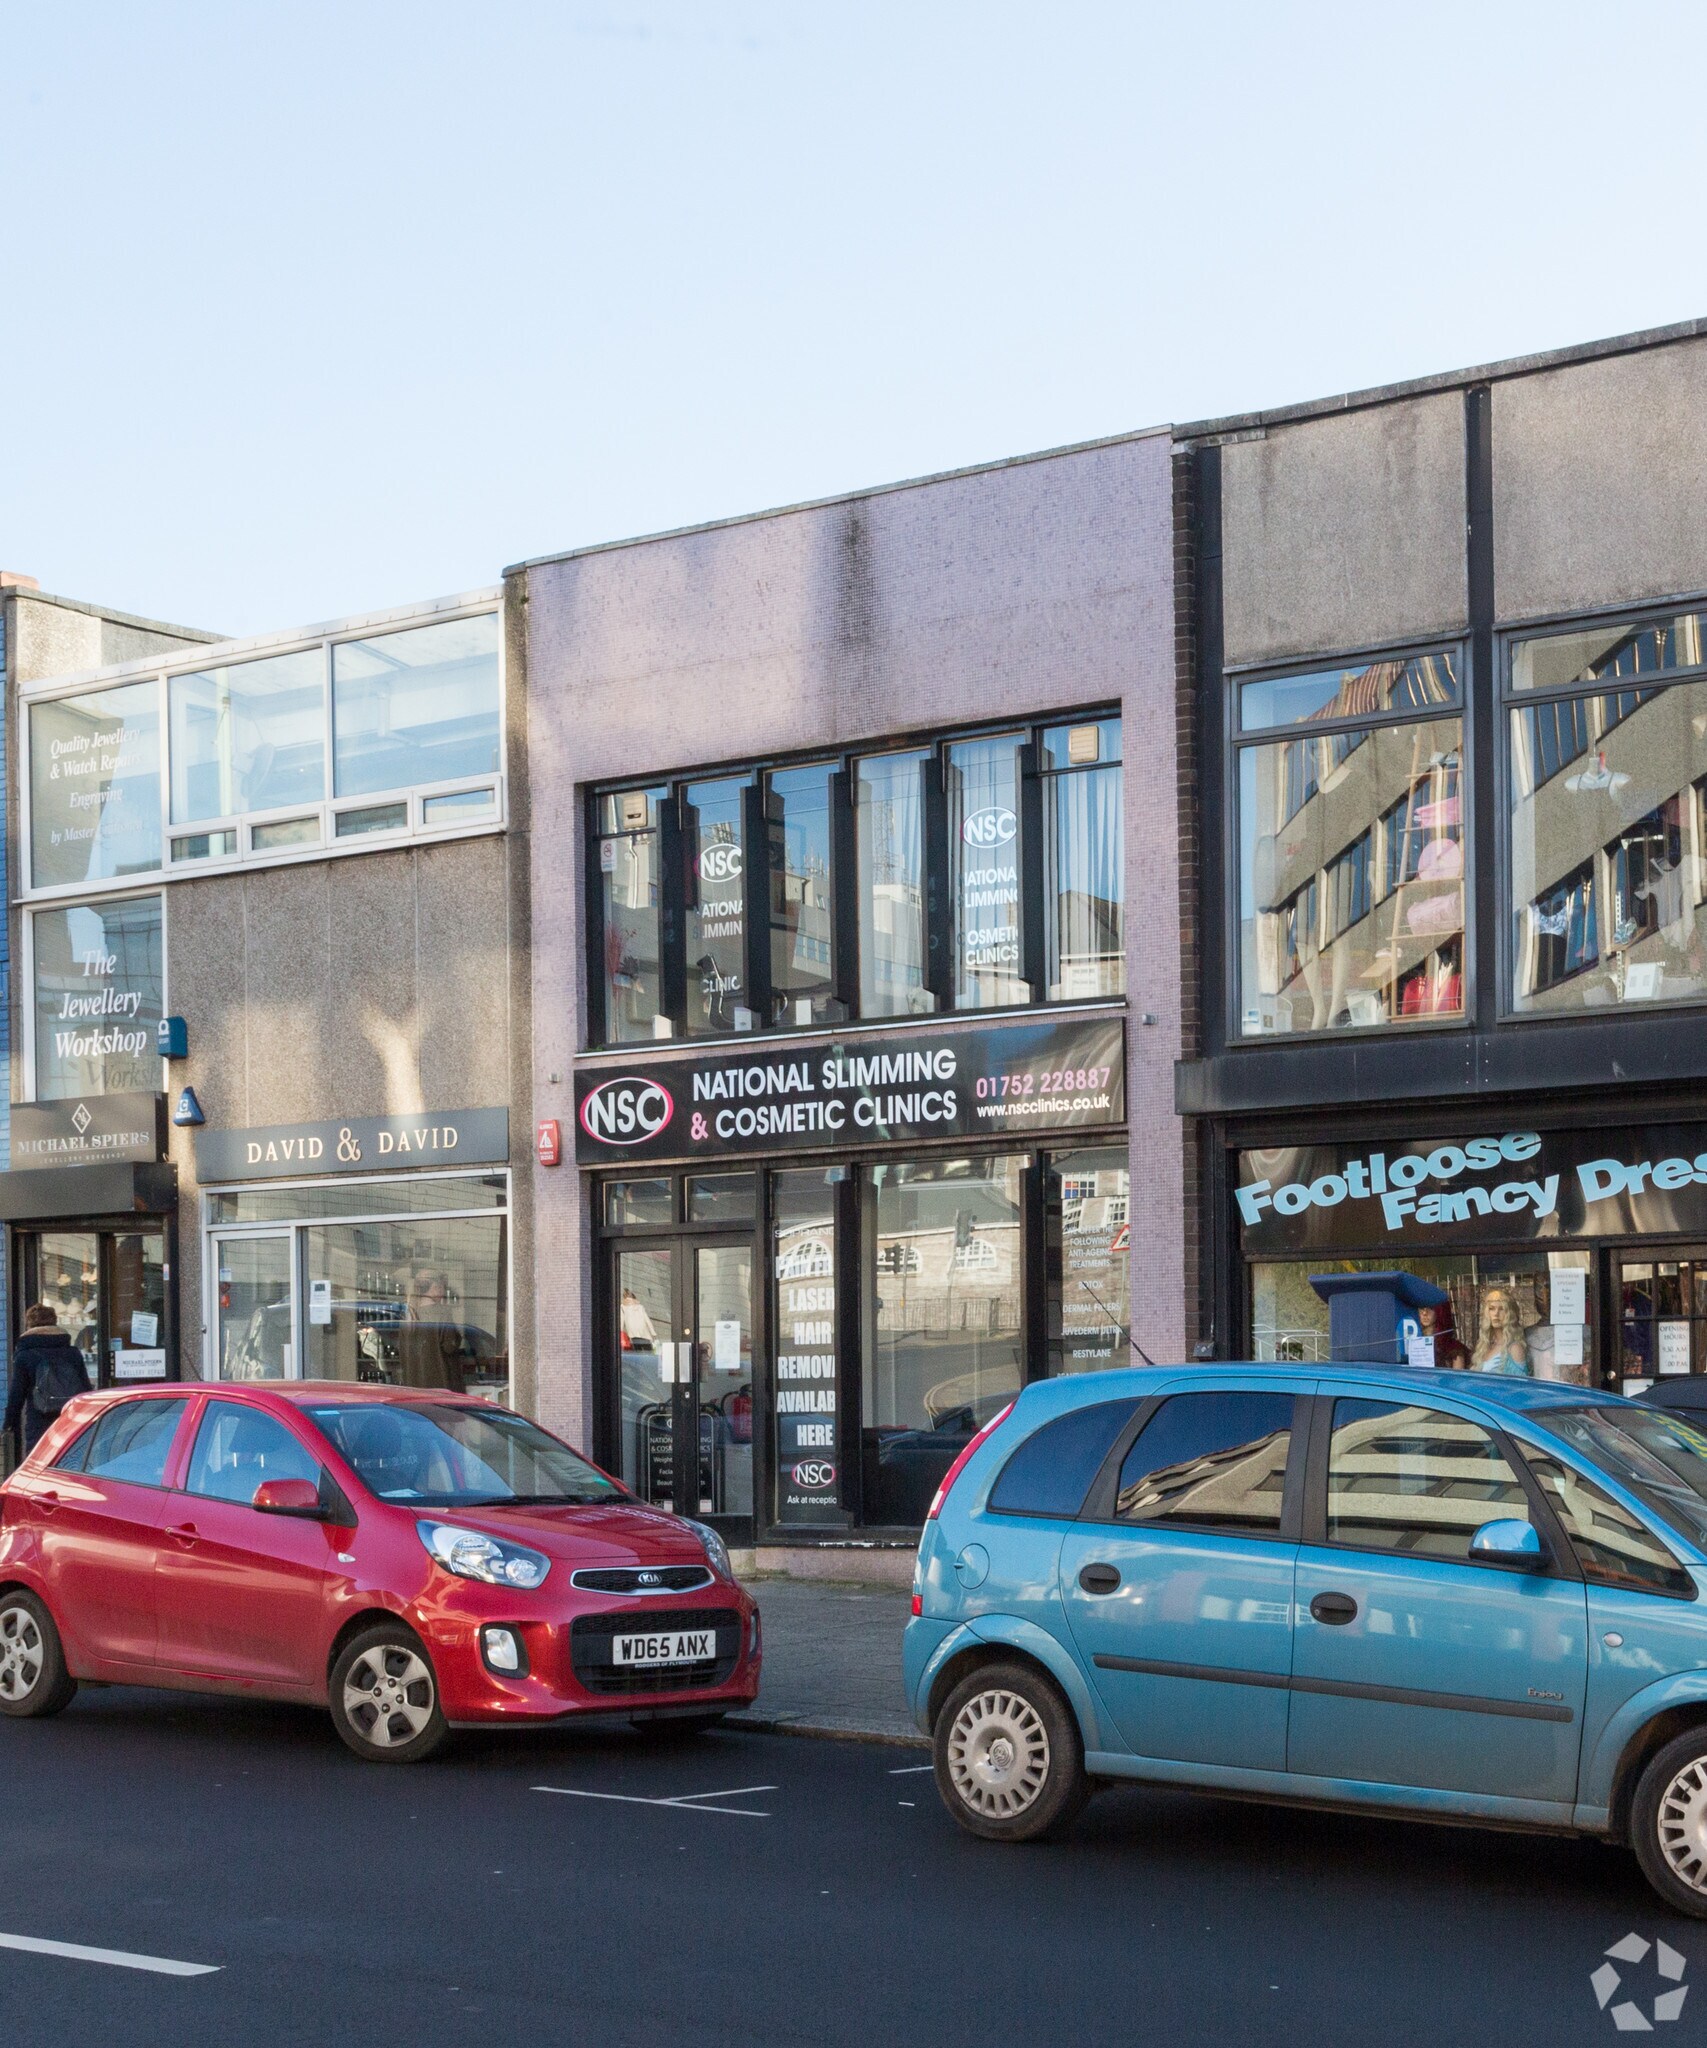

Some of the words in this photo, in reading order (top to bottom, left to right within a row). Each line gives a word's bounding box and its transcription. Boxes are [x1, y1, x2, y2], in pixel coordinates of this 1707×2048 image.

[50, 735, 90, 760] Quality
[91, 727, 140, 749] Jewellery
[50, 763, 60, 779] &
[63, 757, 97, 777] Watch
[69, 786, 123, 810] Engraving
[51, 830, 61, 846] by
[63, 827, 95, 842] Master
[966, 812, 1017, 844] NSC
[700, 847, 742, 877] NSC
[83, 950, 117, 977] The
[965, 944, 1018, 966] CLINICS
[58, 987, 142, 1019] Jewellery
[55, 1027, 147, 1058] Workshop
[693, 1062, 815, 1101] NATIONAL
[822, 1048, 957, 1089] SLIMMING
[976, 1073, 1034, 1098] 01752
[1040, 1067, 1111, 1093] 228887
[591, 1087, 665, 1134] NSC
[690, 1112, 709, 1141] &
[715, 1099, 846, 1138] COSMETIC
[853, 1090, 957, 1127] CLINICS
[976, 1093, 1111, 1118] www.nscclinics.co.uk
[17, 1136, 89, 1154] MICHAEL
[91, 1131, 150, 1149] SPIERS
[247, 1137, 324, 1164] DAVID
[336, 1127, 362, 1162] &
[378, 1127, 458, 1154] DAVID
[1234, 1132, 1542, 1227] Footloose
[1380, 1174, 1560, 1231] Fancy
[1070, 1236, 1111, 1246] FOLLOWING
[1079, 1280, 1104, 1289] BOTOX
[1063, 1304, 1092, 1313] DERMAL
[794, 1321, 832, 1345] HAIR
[1061, 1327, 1099, 1336] JUVEDERM
[1072, 1349, 1112, 1358] RESTYLANE
[796, 1424, 834, 1446] HERE
[797, 1463, 832, 1485] NSC
[787, 1495, 799, 1505] Ask
[800, 1496, 808, 1504] at
[641, 1573, 661, 1584] KIA
[621, 1636, 671, 1660] WD65
[675, 1634, 709, 1657] ANX
[1527, 1687, 1564, 1700] Enjoy
